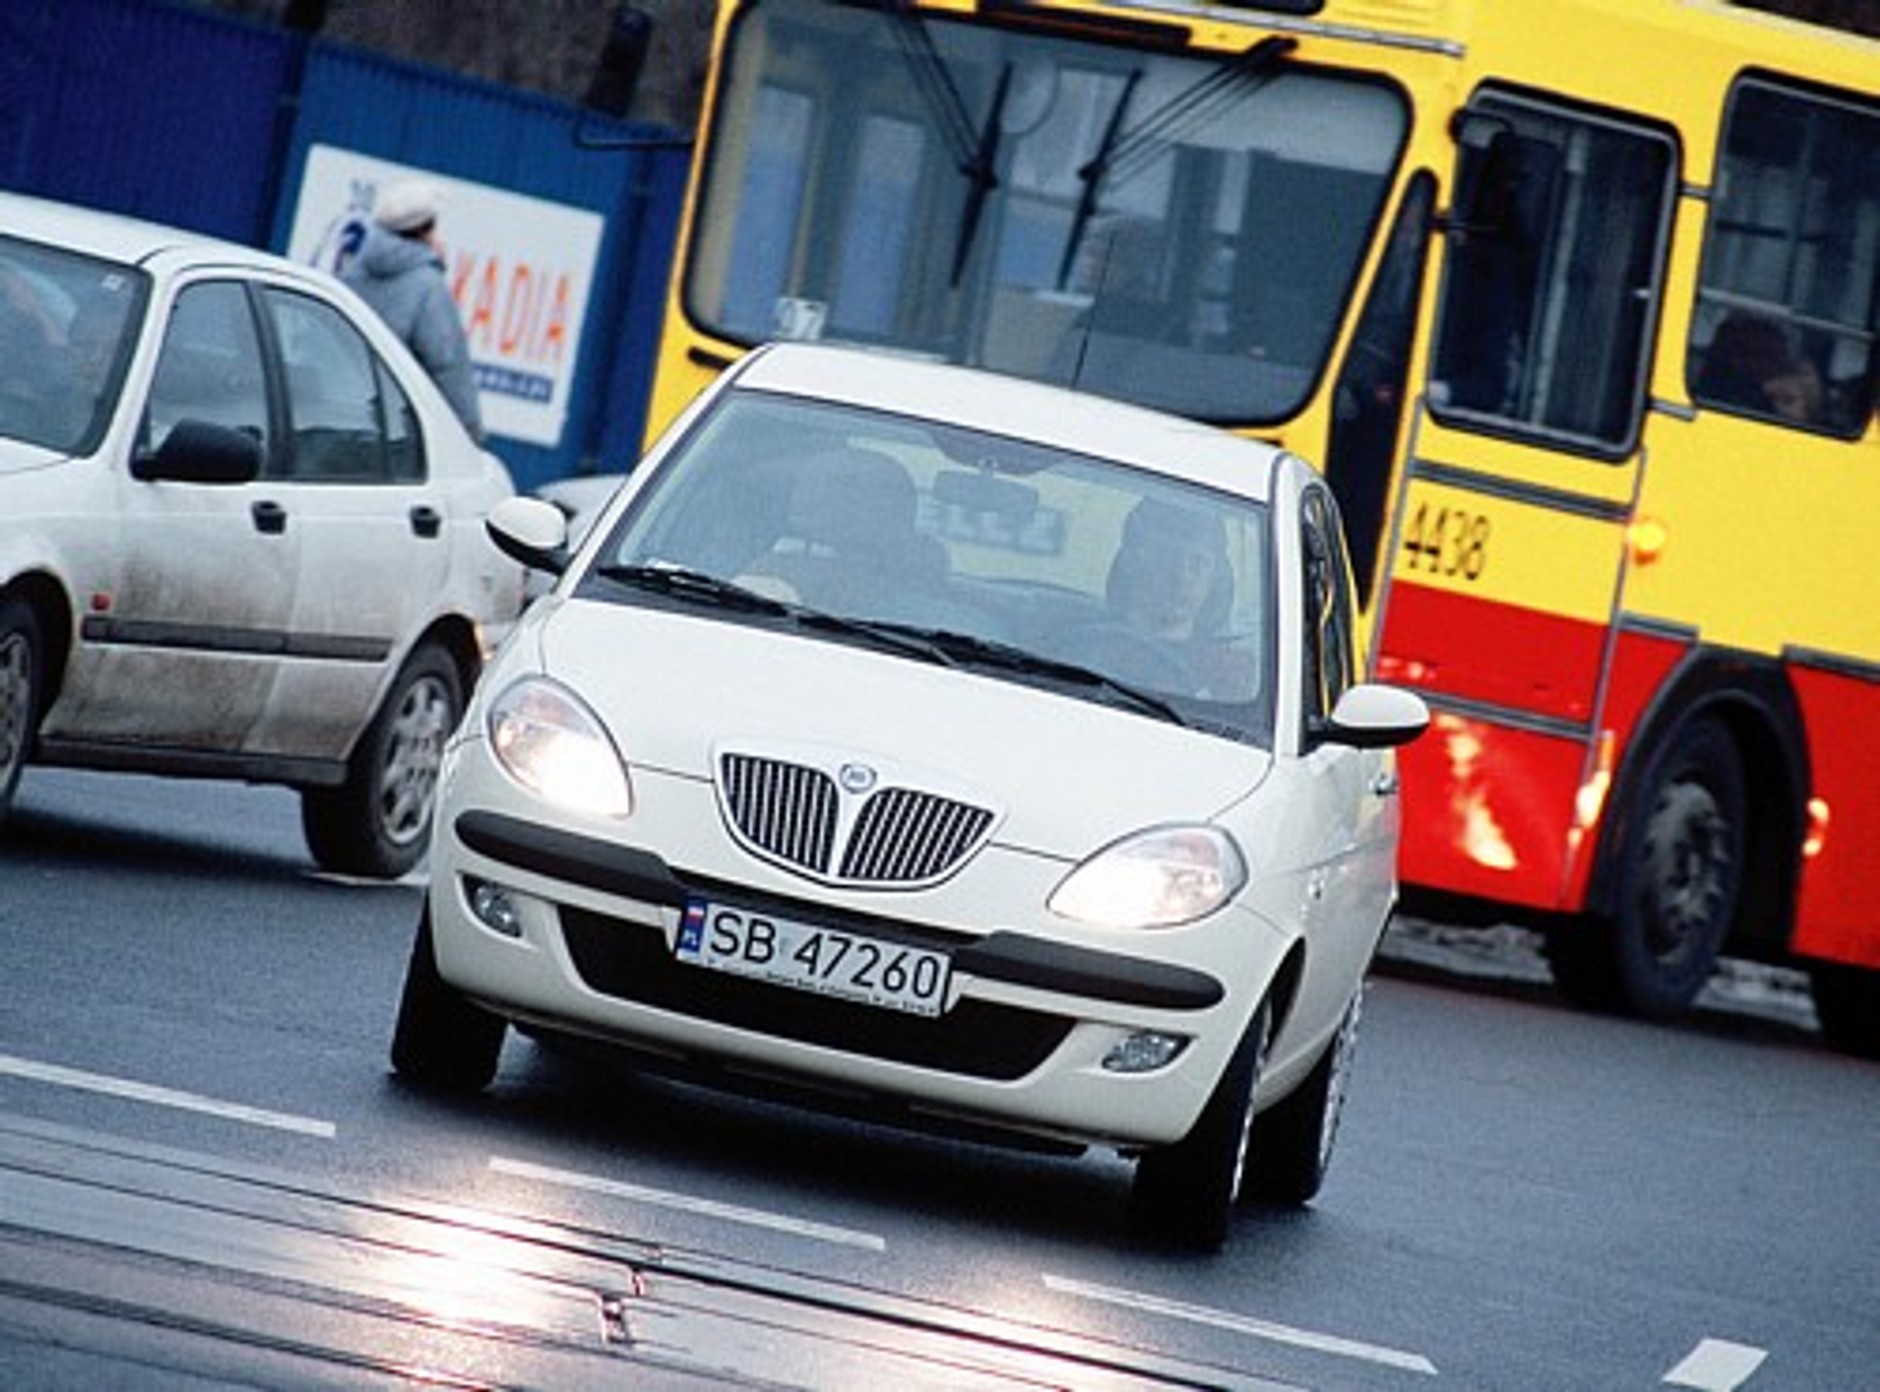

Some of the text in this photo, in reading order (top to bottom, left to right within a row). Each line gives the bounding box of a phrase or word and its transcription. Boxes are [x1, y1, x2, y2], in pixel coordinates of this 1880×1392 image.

[1404, 503, 1491, 581] 4438
[710, 911, 777, 964] SB
[793, 932, 941, 999] 47260
